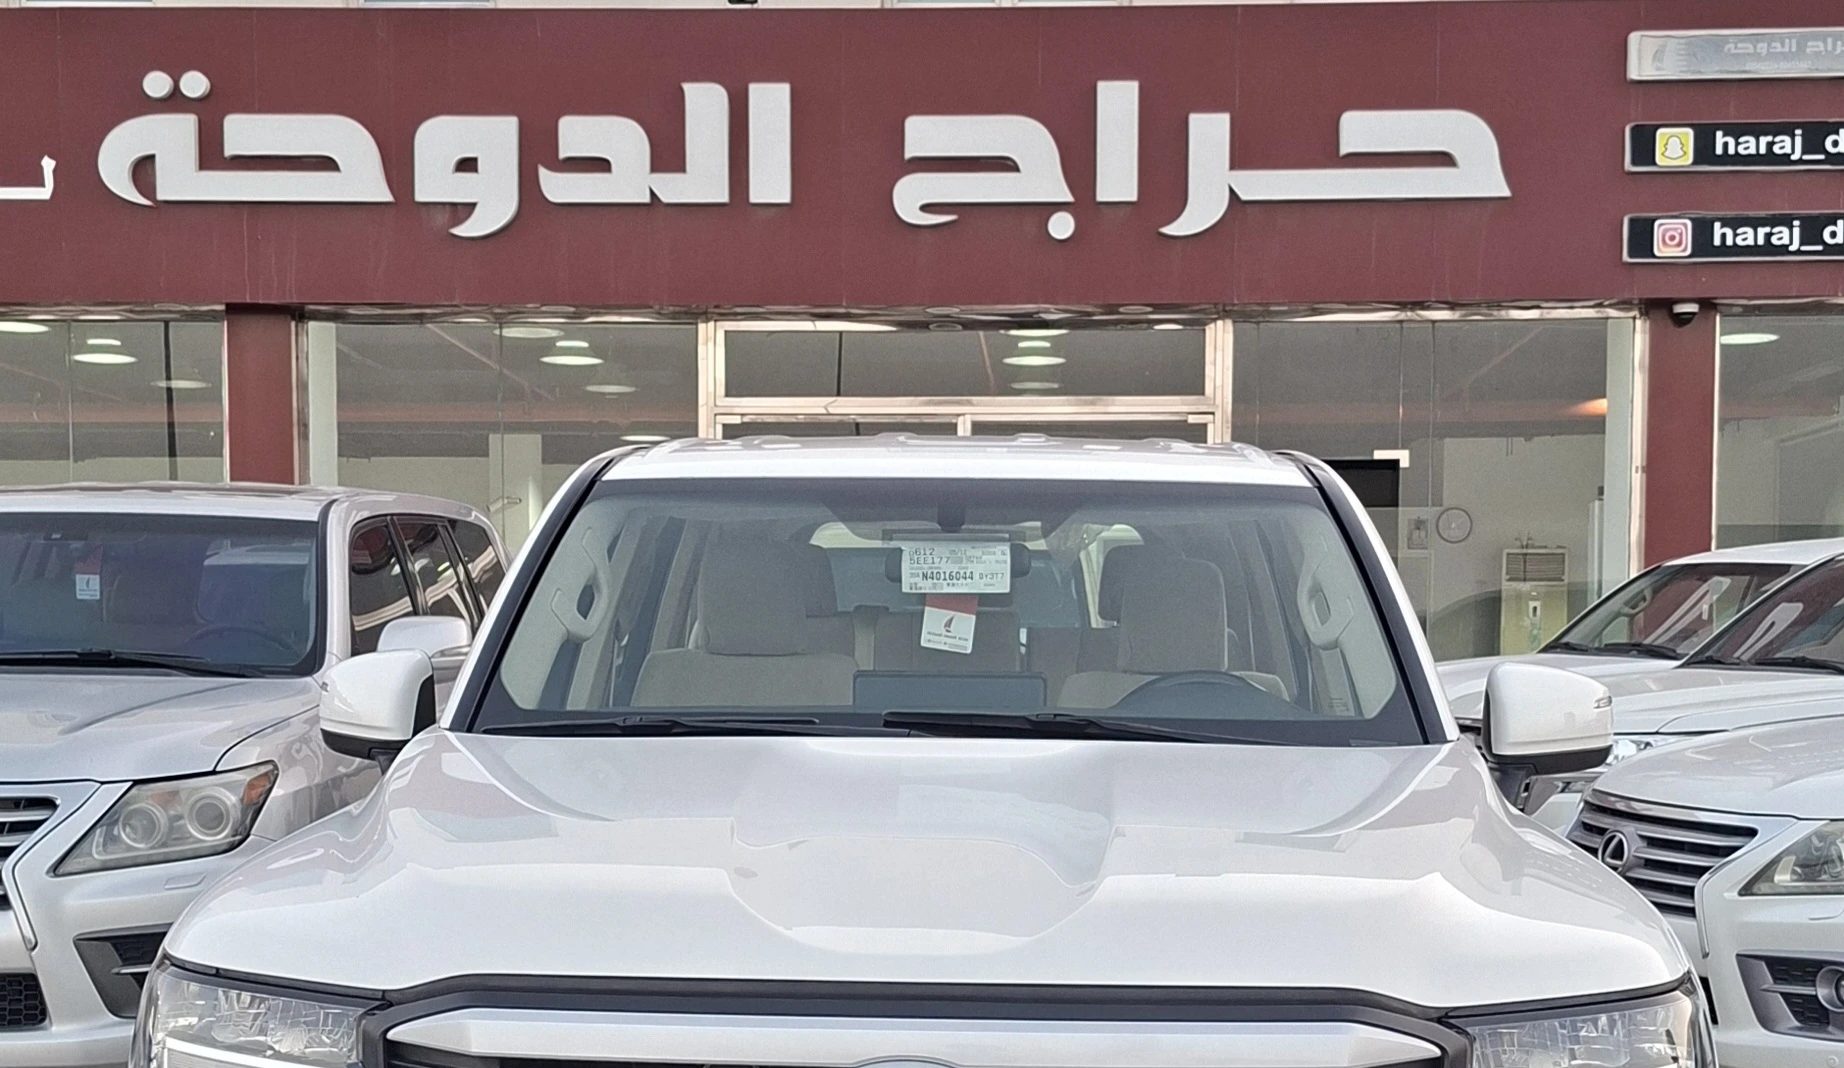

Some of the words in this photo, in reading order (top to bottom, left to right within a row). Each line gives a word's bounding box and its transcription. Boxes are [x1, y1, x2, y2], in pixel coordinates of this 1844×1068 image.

[1724, 38, 1797, 56] الدوحة
[97, 70, 792, 238] الدوحة
[893, 80, 1511, 240] حراج
[921, 571, 975, 581] N4016044
